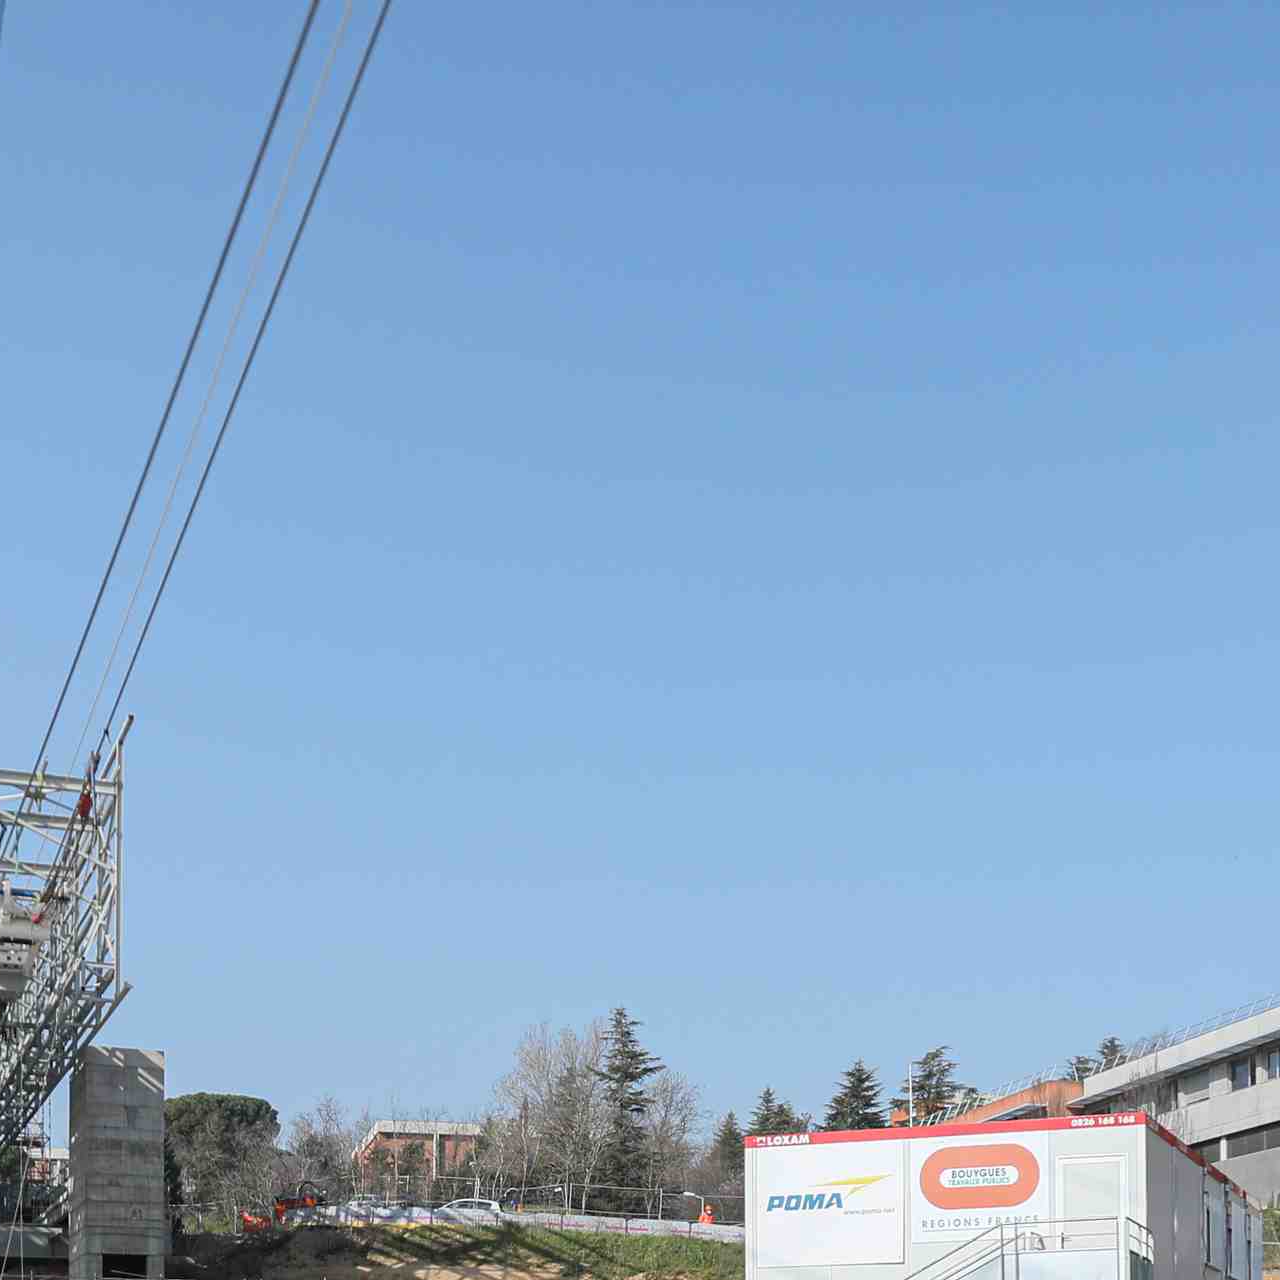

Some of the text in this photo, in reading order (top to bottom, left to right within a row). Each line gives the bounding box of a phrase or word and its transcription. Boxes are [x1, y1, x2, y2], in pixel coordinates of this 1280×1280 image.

[767, 1135, 810, 1146] LOXAM
[951, 1168, 1007, 1179] BOUYGUES
[766, 1192, 844, 1212] POMA
